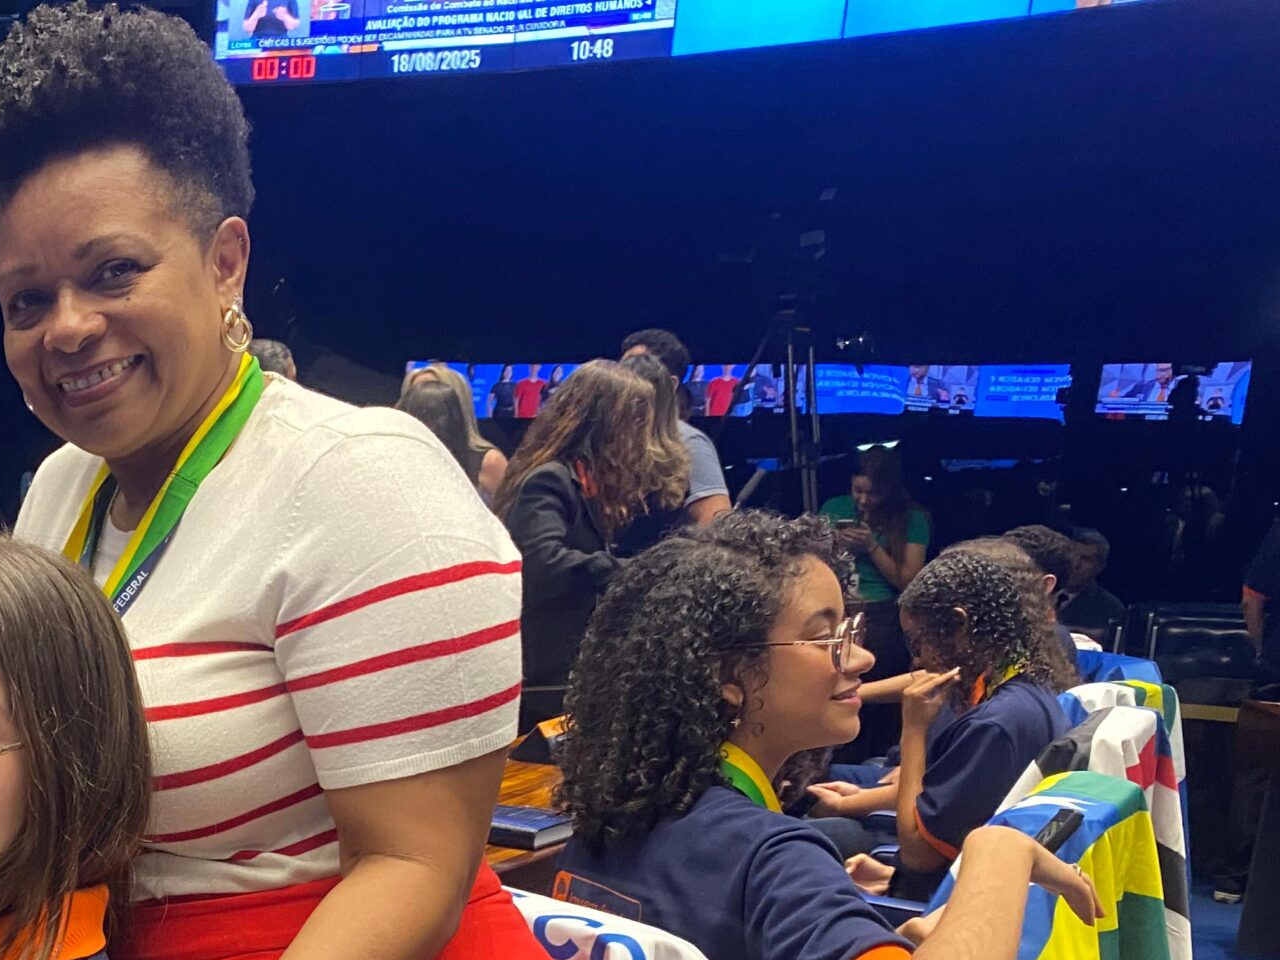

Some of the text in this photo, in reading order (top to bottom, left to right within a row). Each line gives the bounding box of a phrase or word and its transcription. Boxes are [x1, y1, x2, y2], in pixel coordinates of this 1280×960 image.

[365, 15, 415, 31] AVALIAÇÃO
[417, 16, 430, 27] DO
[432, 13, 483, 26] PROGRAMA
[535, 7, 548, 18] DE
[550, 3, 593, 17] DIREITOS
[595, 0, 643, 12] HUMANOS
[430, 2, 441, 11] de
[474, 25, 504, 35] SENADO
[391, 49, 481, 73] 18/08/2025
[570, 38, 614, 60] 10:48
[254, 56, 316, 80] 00:00
[113, 570, 149, 613] FEDERAL
